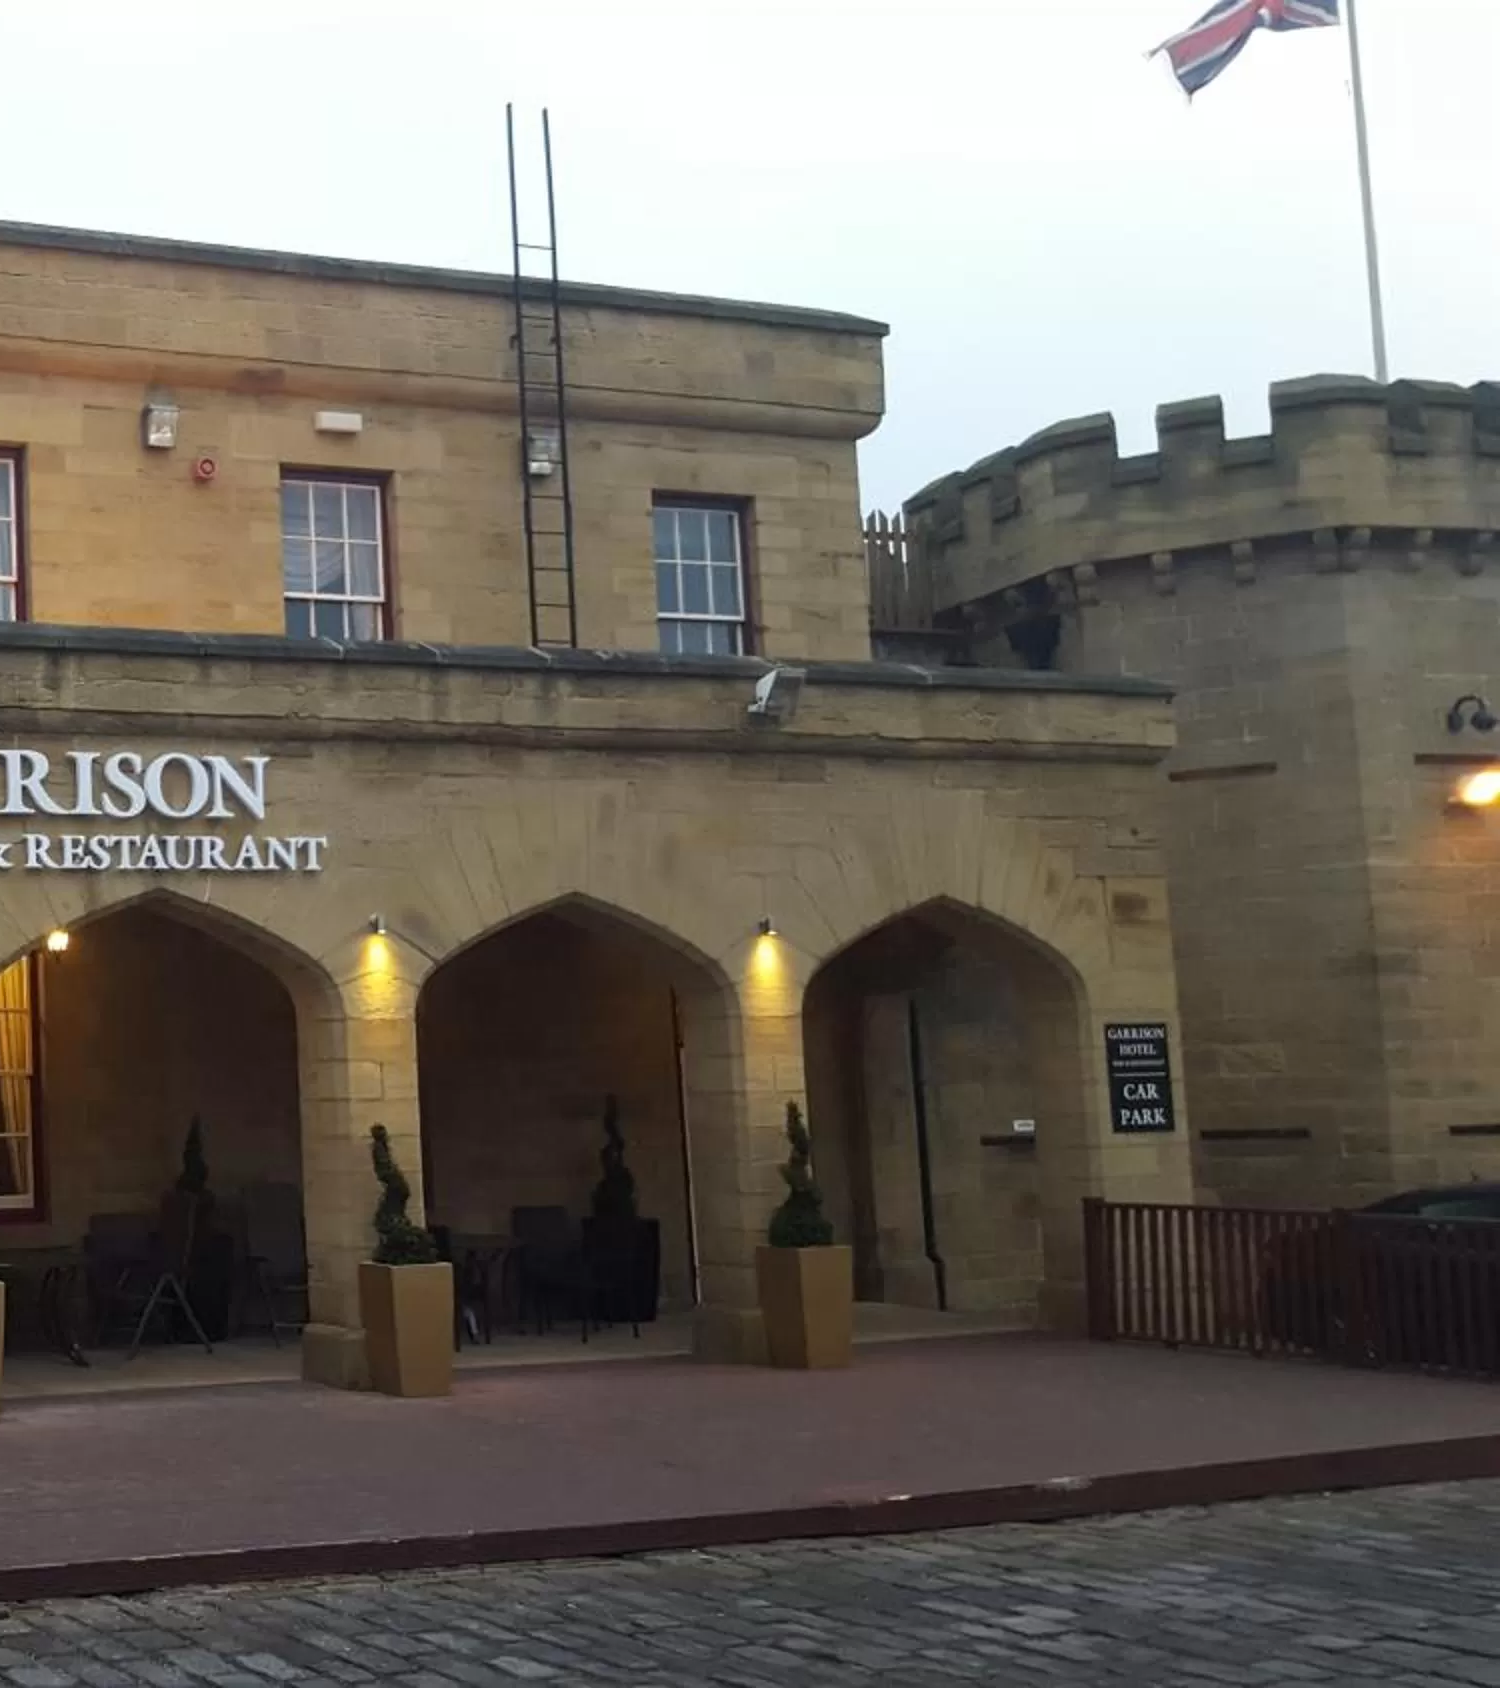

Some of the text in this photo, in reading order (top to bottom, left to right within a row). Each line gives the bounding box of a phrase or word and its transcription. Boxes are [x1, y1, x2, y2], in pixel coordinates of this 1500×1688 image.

[23, 834, 327, 871] RESTAURANT
[1107, 1027, 1165, 1040] GARRISON
[1119, 1043, 1157, 1056] HOTEL
[1123, 1083, 1159, 1100] CAR
[1120, 1107, 1166, 1126] PARK
